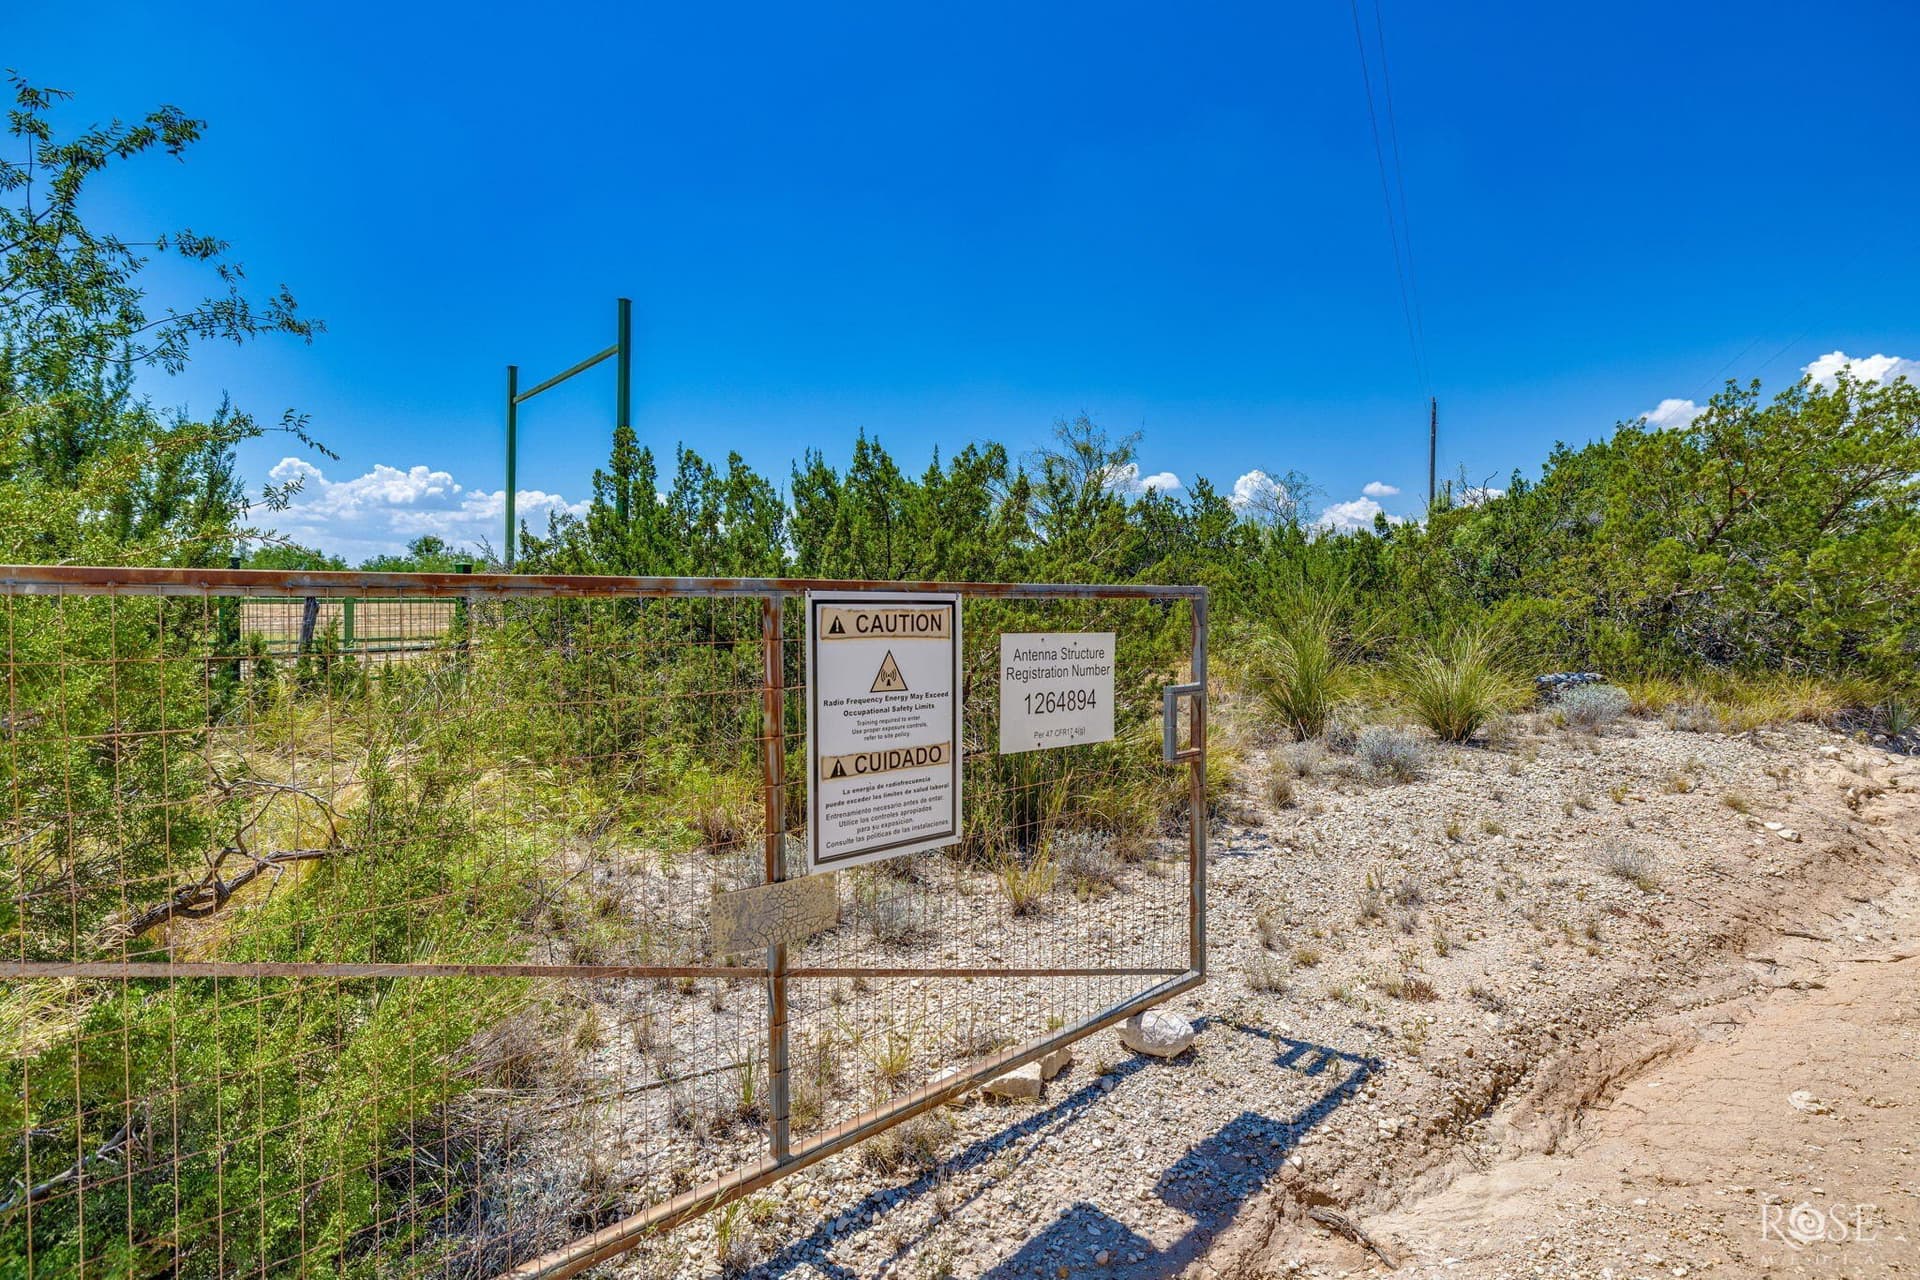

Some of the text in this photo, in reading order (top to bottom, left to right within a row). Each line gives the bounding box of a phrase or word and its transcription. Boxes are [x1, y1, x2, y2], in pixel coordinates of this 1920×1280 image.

[856, 614, 942, 633] CAUTION
[1013, 647, 1104, 662] Antenna Structure
[1006, 664, 1111, 684] Registration Number
[823, 699, 844, 707] Radio
[846, 696, 883, 706] Frequency
[884, 694, 908, 702] Energy
[924, 691, 949, 699] Exceed
[1024, 688, 1097, 715] 1264894
[843, 702, 935, 717] Occupational Safety Limits
[855, 746, 942, 774] CUIDADO
[885, 776, 931, 788] radiofrecuencia
[826, 800, 845, 810] puede
[846, 796, 871, 804] exceder
[826, 807, 872, 821] Entrenamiento
[872, 802, 902, 812] necesario
[838, 820, 858, 828] Utilice
[870, 811, 898, 822] controles
[826, 838, 855, 848] Consulte
